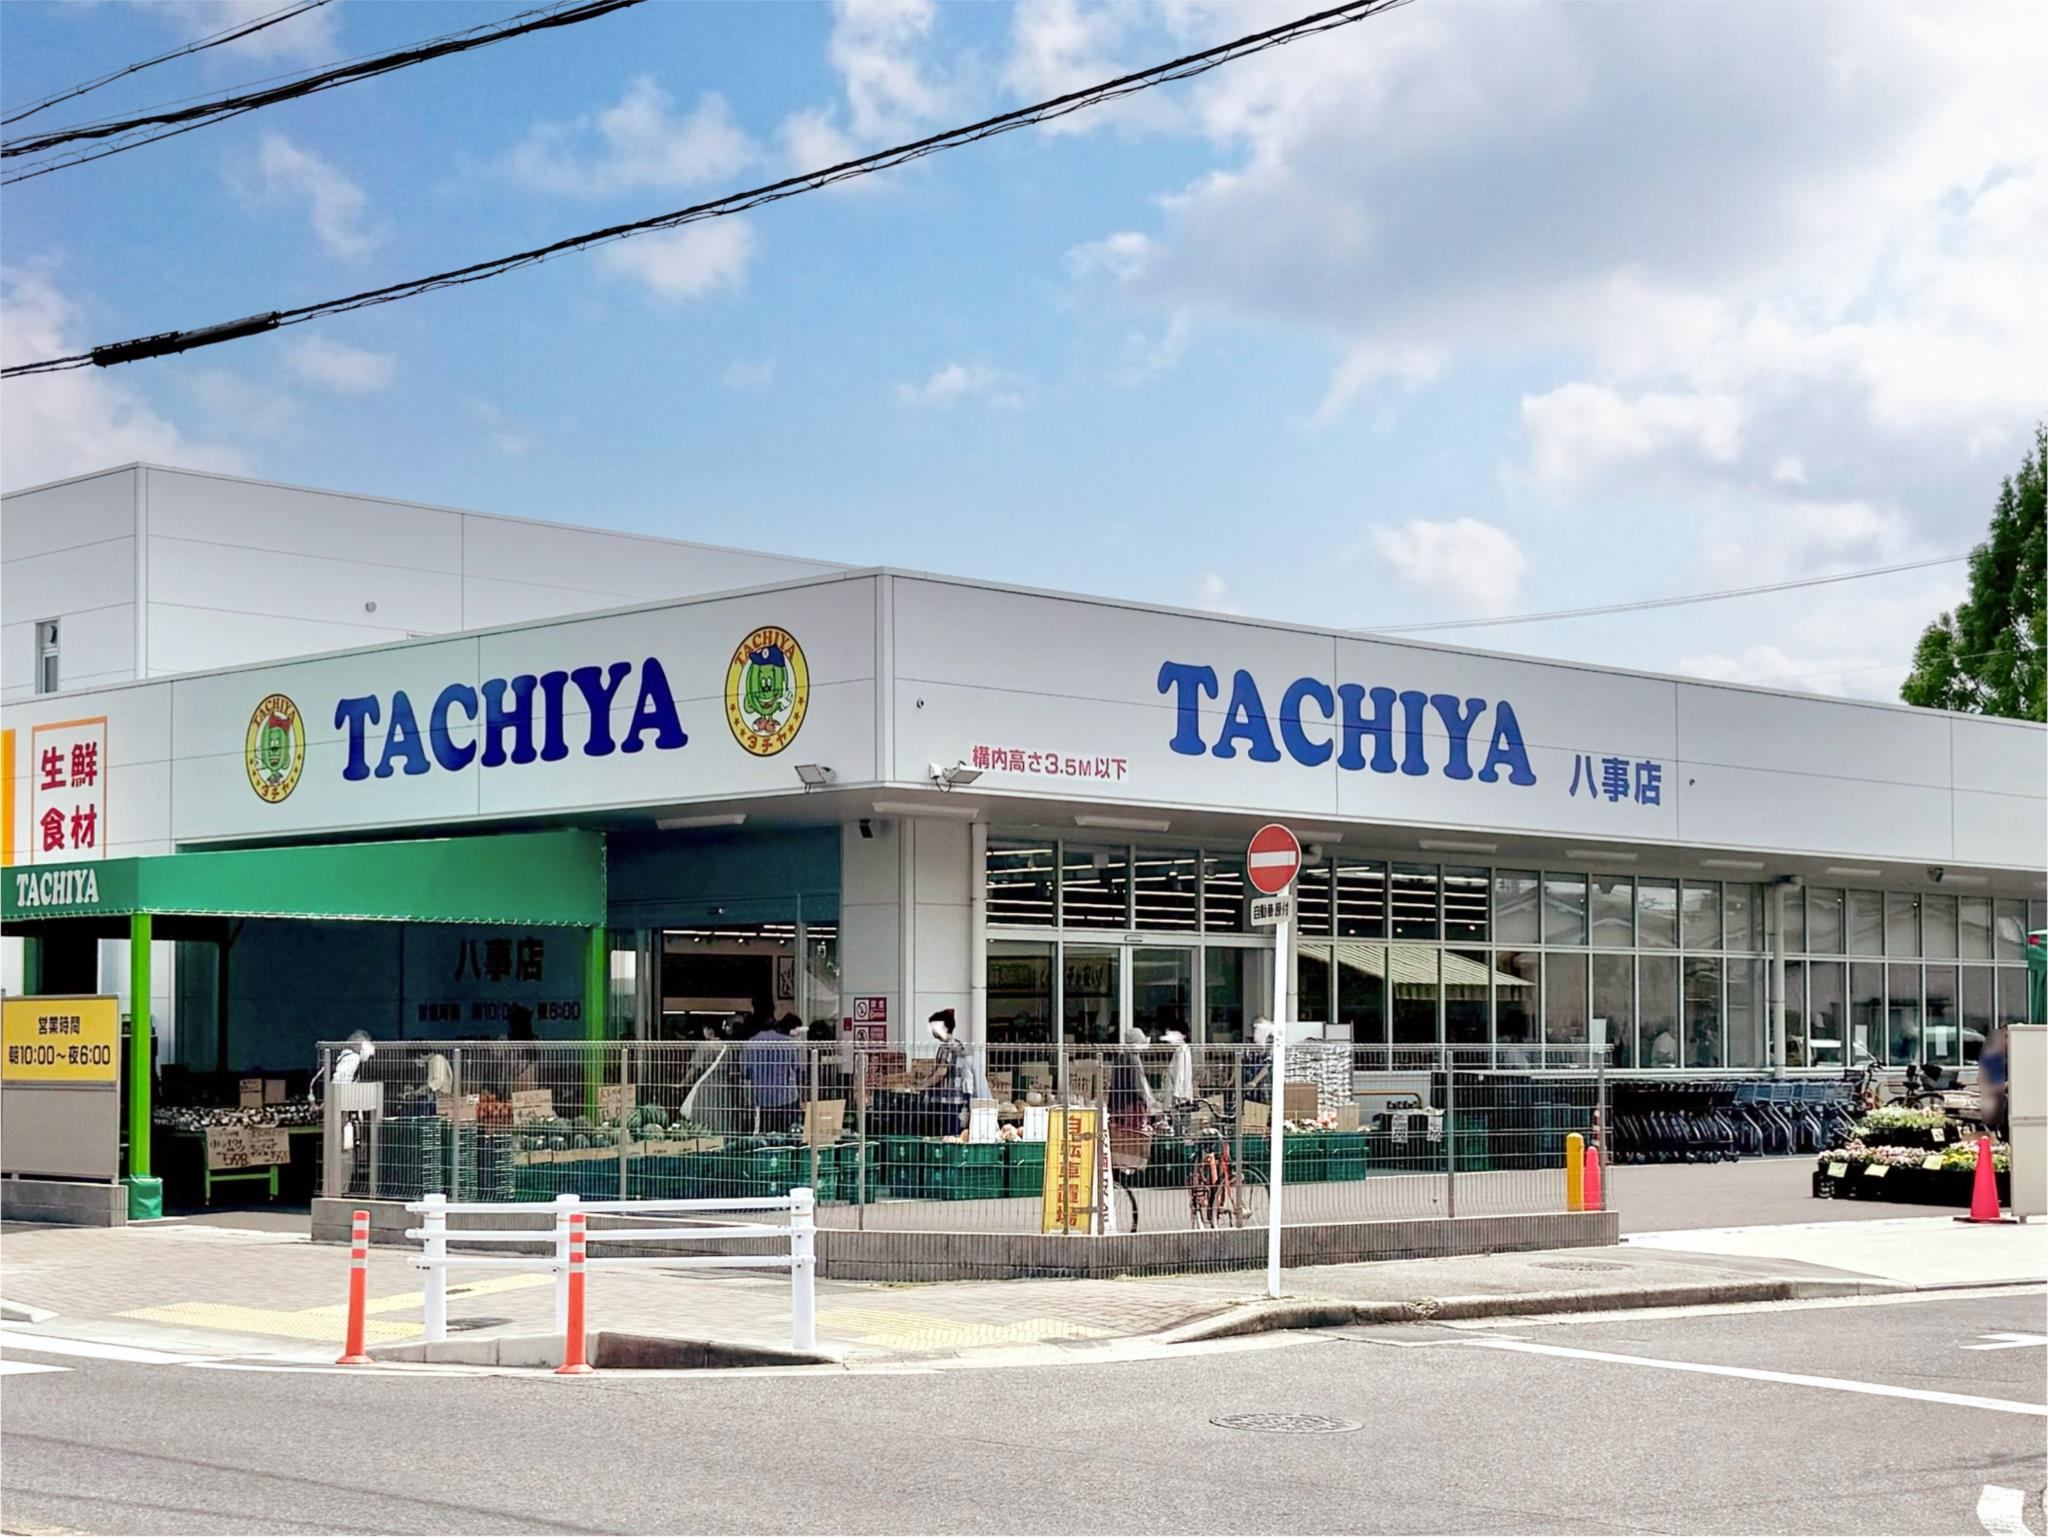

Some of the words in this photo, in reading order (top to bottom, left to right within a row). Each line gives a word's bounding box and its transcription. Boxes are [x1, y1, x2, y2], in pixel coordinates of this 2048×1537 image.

[735, 630, 796, 665] TACHIYA
[253, 697, 296, 726] TACHIYA
[334, 657, 689, 781] TACHIYA
[1157, 660, 1537, 786] TACHIYA
[748, 733, 787, 753] タチヤ
[972, 744, 1127, 781] 構内高さ3.5M以下
[41, 741, 98, 791] 生鮮
[1569, 753, 1662, 806] 八事店
[40, 803, 98, 852] 食材
[16, 868, 100, 907] TACHIYA
[38, 1016, 80, 1035] 営業時間
